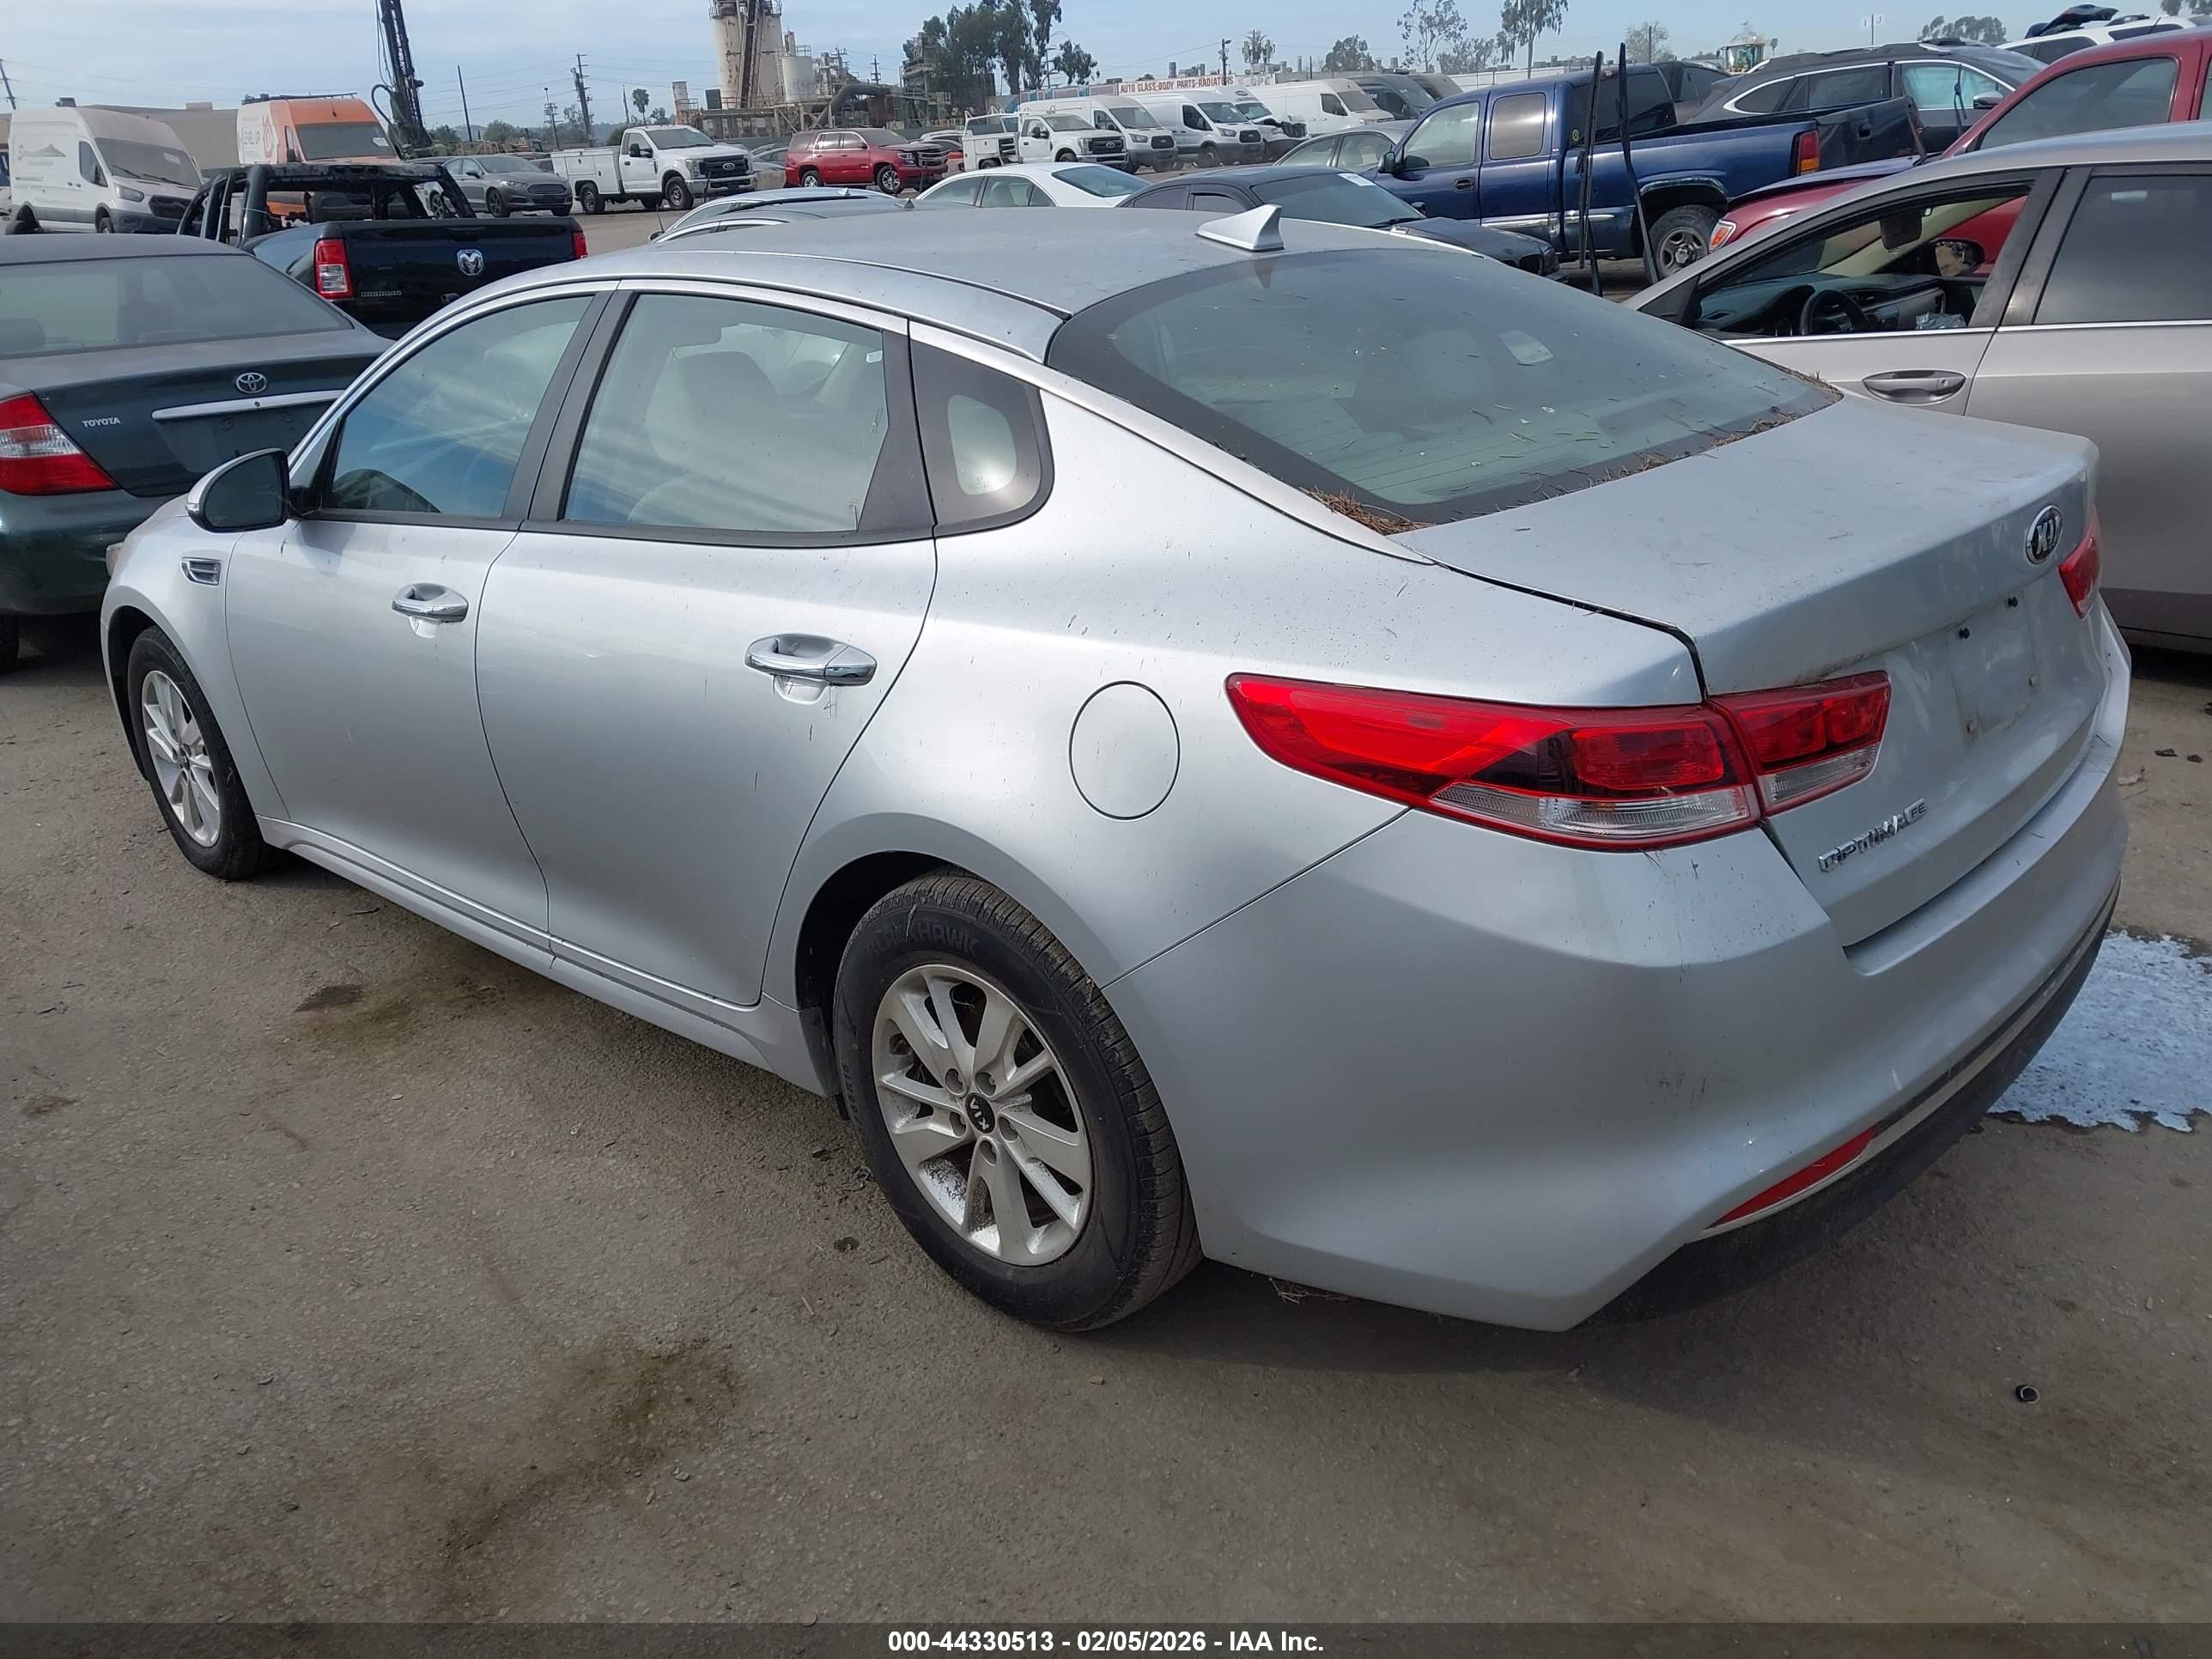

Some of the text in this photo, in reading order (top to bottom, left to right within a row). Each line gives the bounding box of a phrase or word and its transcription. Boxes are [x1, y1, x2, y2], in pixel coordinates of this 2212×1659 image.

[1120, 84, 1135, 94] AUTO
[82, 417, 122, 428] TOYOTA
[1819, 814, 1905, 872] OPTIMA
[969, 1097, 990, 1130] KIA
